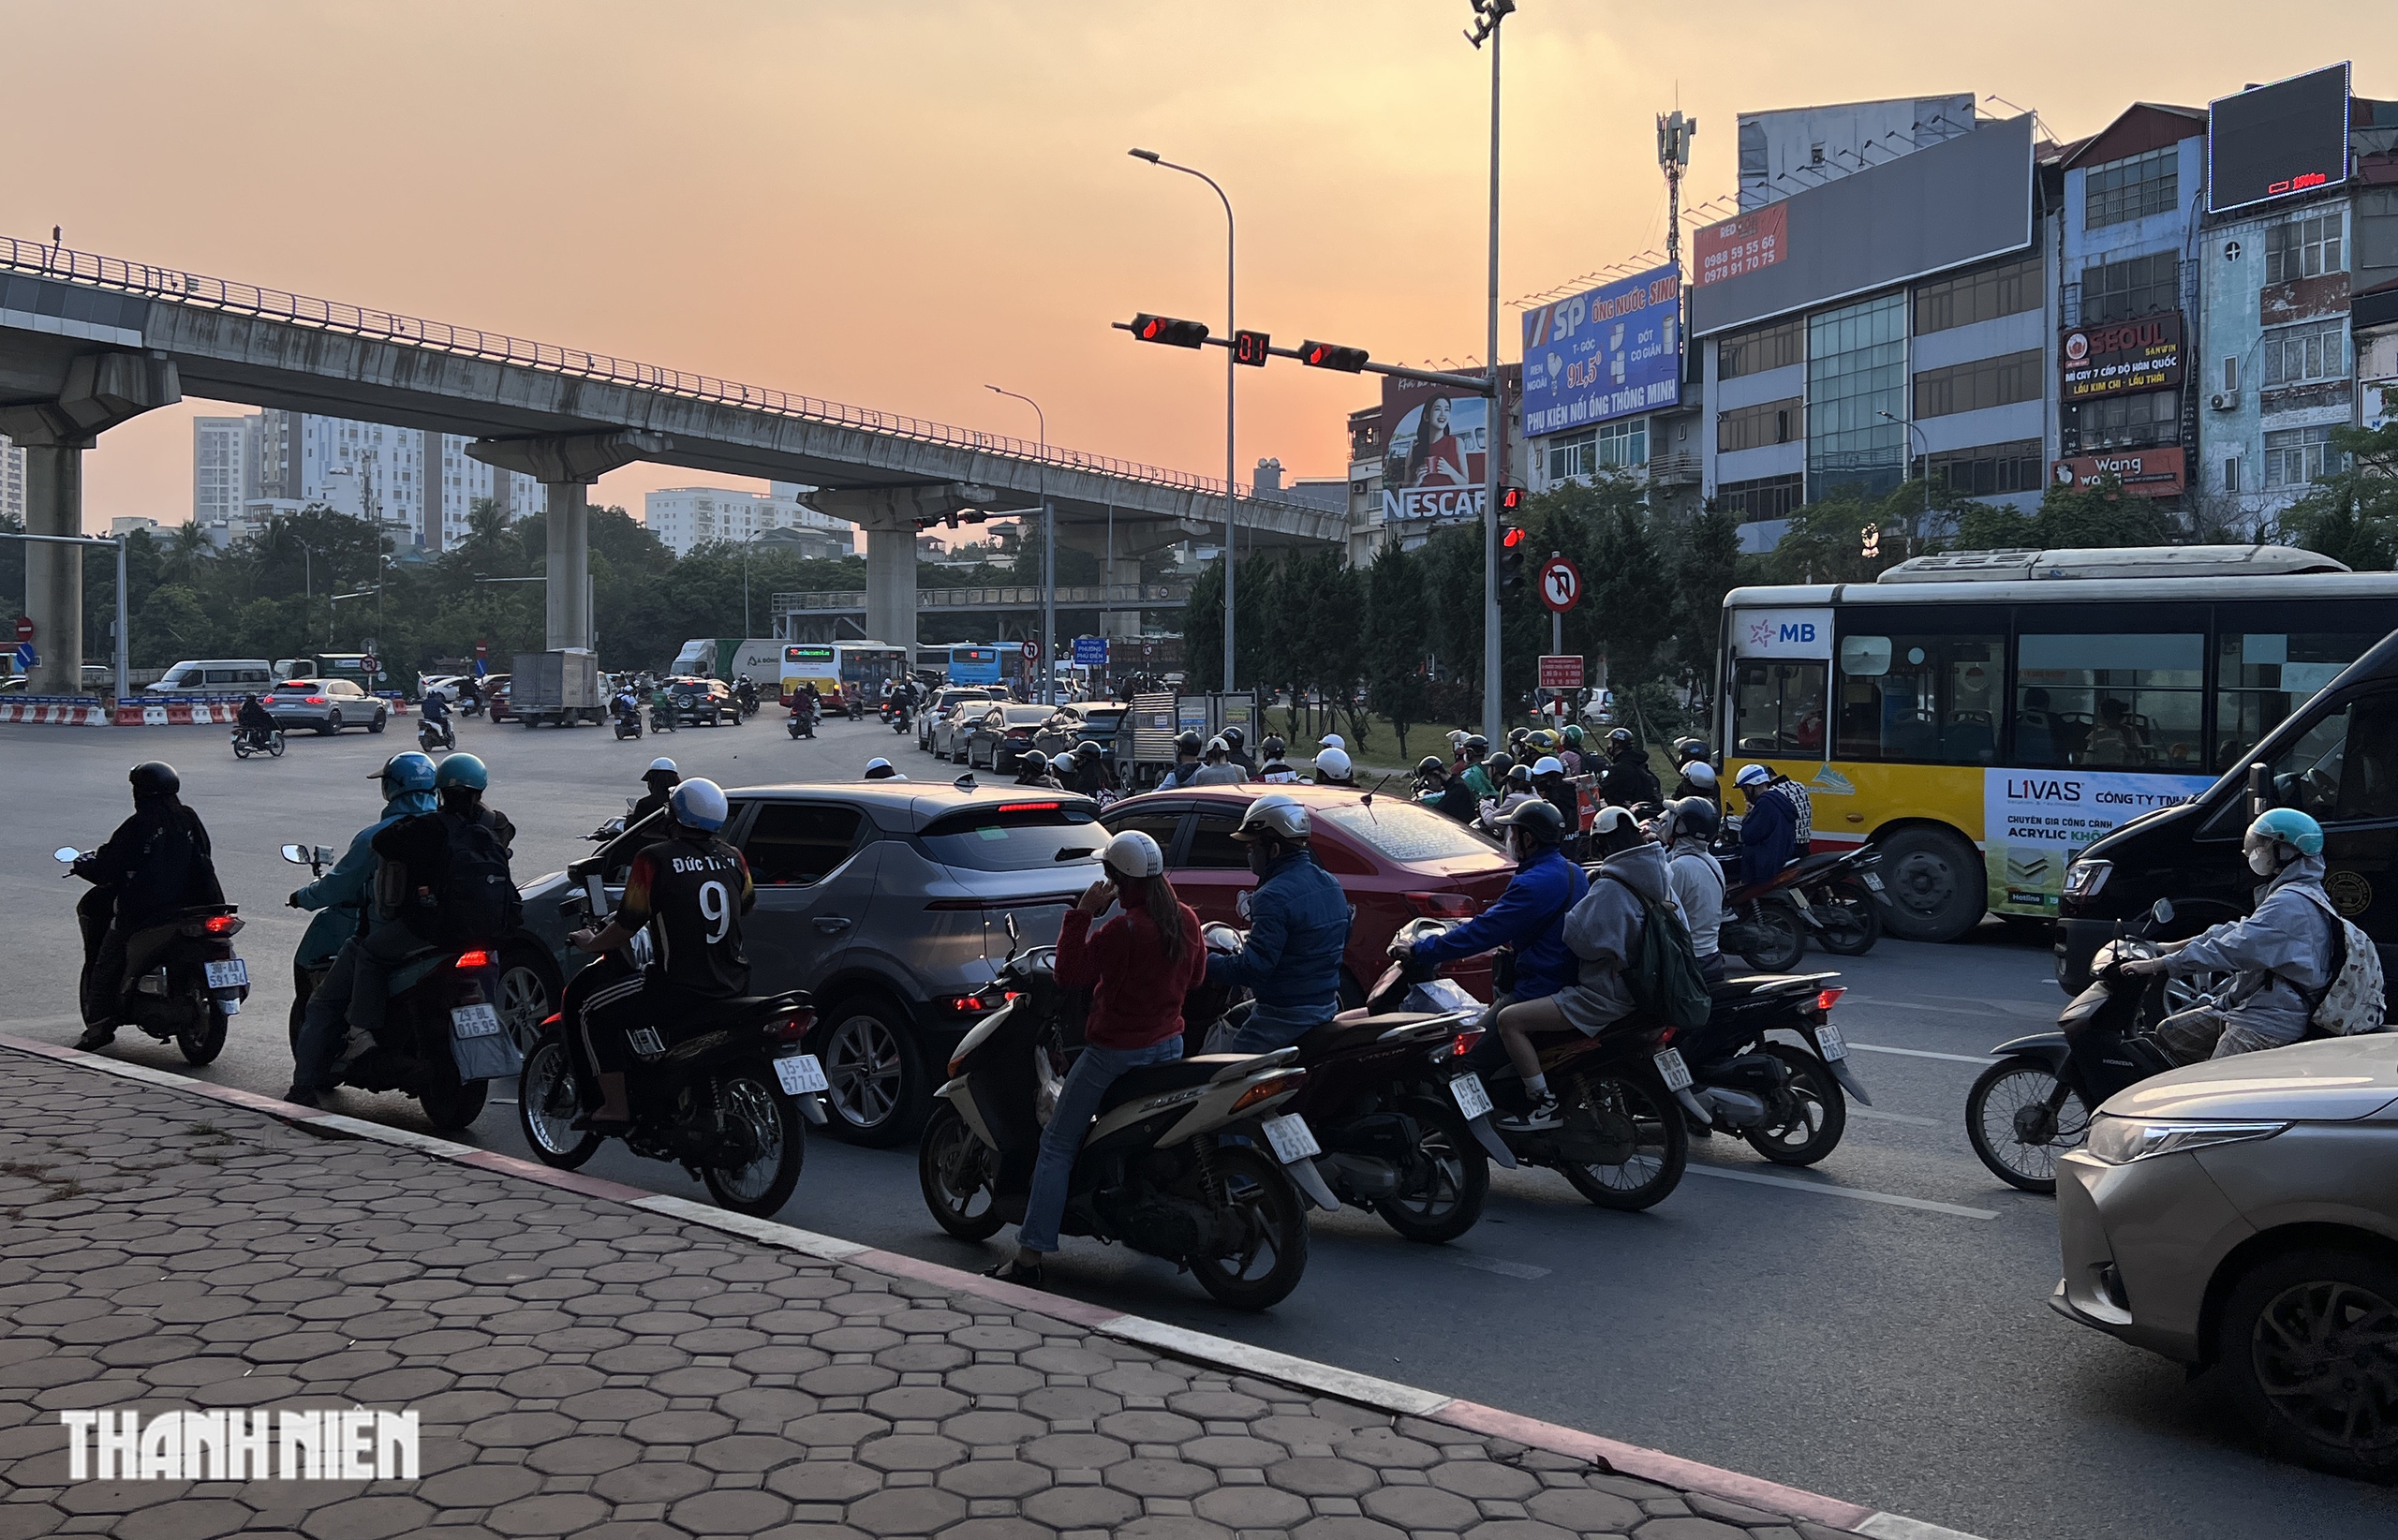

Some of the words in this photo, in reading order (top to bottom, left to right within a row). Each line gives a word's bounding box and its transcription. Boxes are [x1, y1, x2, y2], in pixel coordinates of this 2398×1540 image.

[1705, 250, 1728, 268] 0988
[1731, 245, 1743, 259] 59
[1746, 241, 1758, 255] 55
[1762, 234, 1774, 249] 66
[1705, 265, 1728, 283] 0978
[1731, 260, 1742, 274] 91
[1746, 256, 1758, 270] 70
[1762, 250, 1774, 265] 75
[1592, 296, 1614, 323] ỐNG
[1616, 286, 1646, 317] NƯỚC
[1649, 274, 1678, 305] SINO
[1553, 296, 1586, 342] SP
[2090, 323, 2167, 355] SEOUL
[1530, 364, 1543, 375] REN
[2065, 370, 2076, 382] MÌ
[2094, 369, 2099, 378] 7
[2091, 381, 2107, 392] KIM
[2108, 379, 2122, 389] CHI
[1527, 410, 1545, 433] PHỤ
[1547, 403, 1568, 430] KIỆN
[1570, 395, 1587, 422] NỐI
[1589, 392, 1609, 416] ỐNG
[1611, 386, 1645, 412] THÔNG
[1647, 378, 1676, 405] MINH
[2095, 457, 2141, 474] Wang
[1383, 483, 1486, 520] NESCAF
[1779, 623, 1816, 644] MB
[2095, 791, 2134, 805] CÔNG
[2136, 794, 2154, 806] TY
[2007, 815, 2042, 825] CHUYÊN
[2045, 817, 2060, 825] GIA
[2007, 827, 2067, 840] ACRYLIC
[2071, 830, 2105, 841] KHÔ
[672, 856, 703, 873] Đức
[2012, 894, 2040, 902] Hotline
[699, 881, 731, 944] 9
[457, 1019, 496, 1036] 016.95
